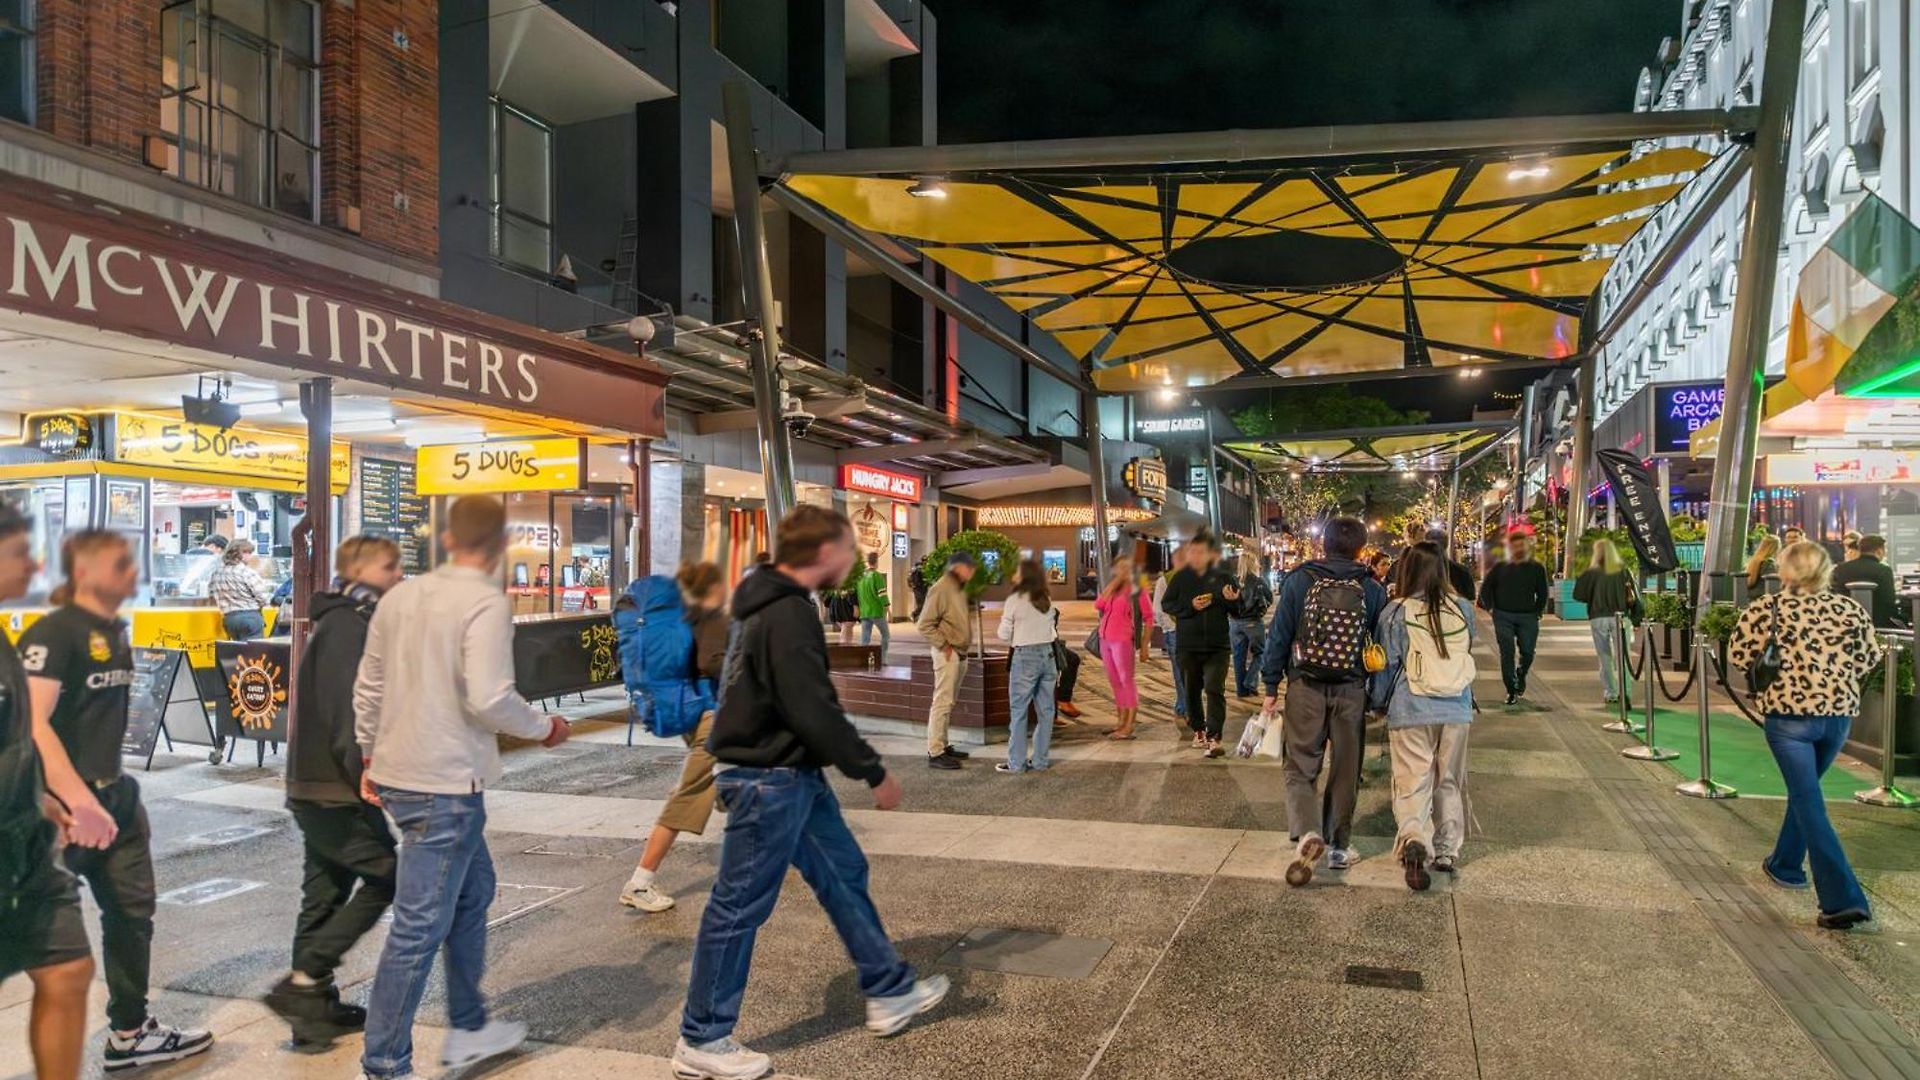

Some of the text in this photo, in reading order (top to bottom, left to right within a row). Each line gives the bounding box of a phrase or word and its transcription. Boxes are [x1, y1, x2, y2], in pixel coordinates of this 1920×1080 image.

[1673, 389, 1725, 404] GAME
[1671, 403, 1721, 418] ARCA
[1688, 418, 1711, 431] BA
[162, 424, 184, 453] 5
[188, 427, 260, 459] DOGS
[452, 452, 470, 480] 5
[852, 468, 890, 491] HUNGRY
[1616, 463, 1641, 506] FREE
[1634, 513, 1660, 565] ENTRY
